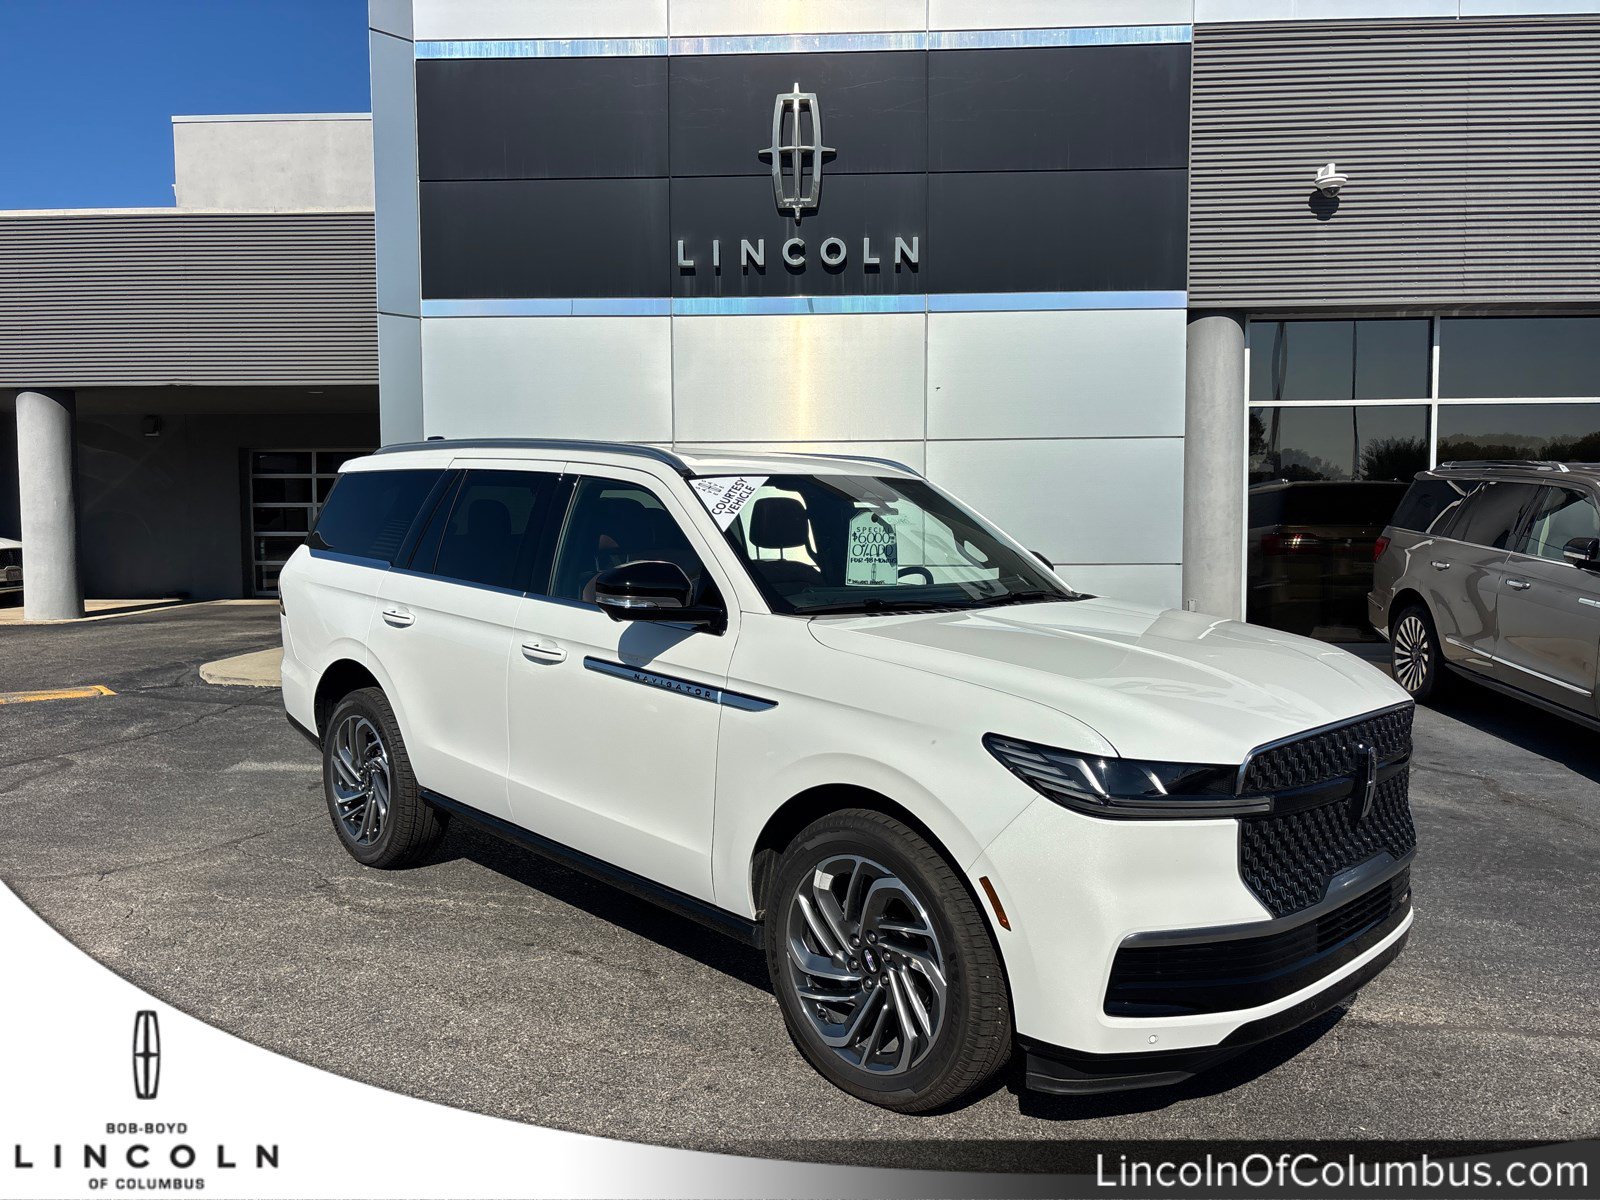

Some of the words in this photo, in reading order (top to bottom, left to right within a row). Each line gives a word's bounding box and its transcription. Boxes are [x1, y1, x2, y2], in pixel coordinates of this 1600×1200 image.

[678, 236, 919, 267] LINCOLN
[711, 477, 748, 515] COURTESY
[724, 485, 756, 515] VEHICLE
[633, 674, 711, 698] NAVIGATOR
